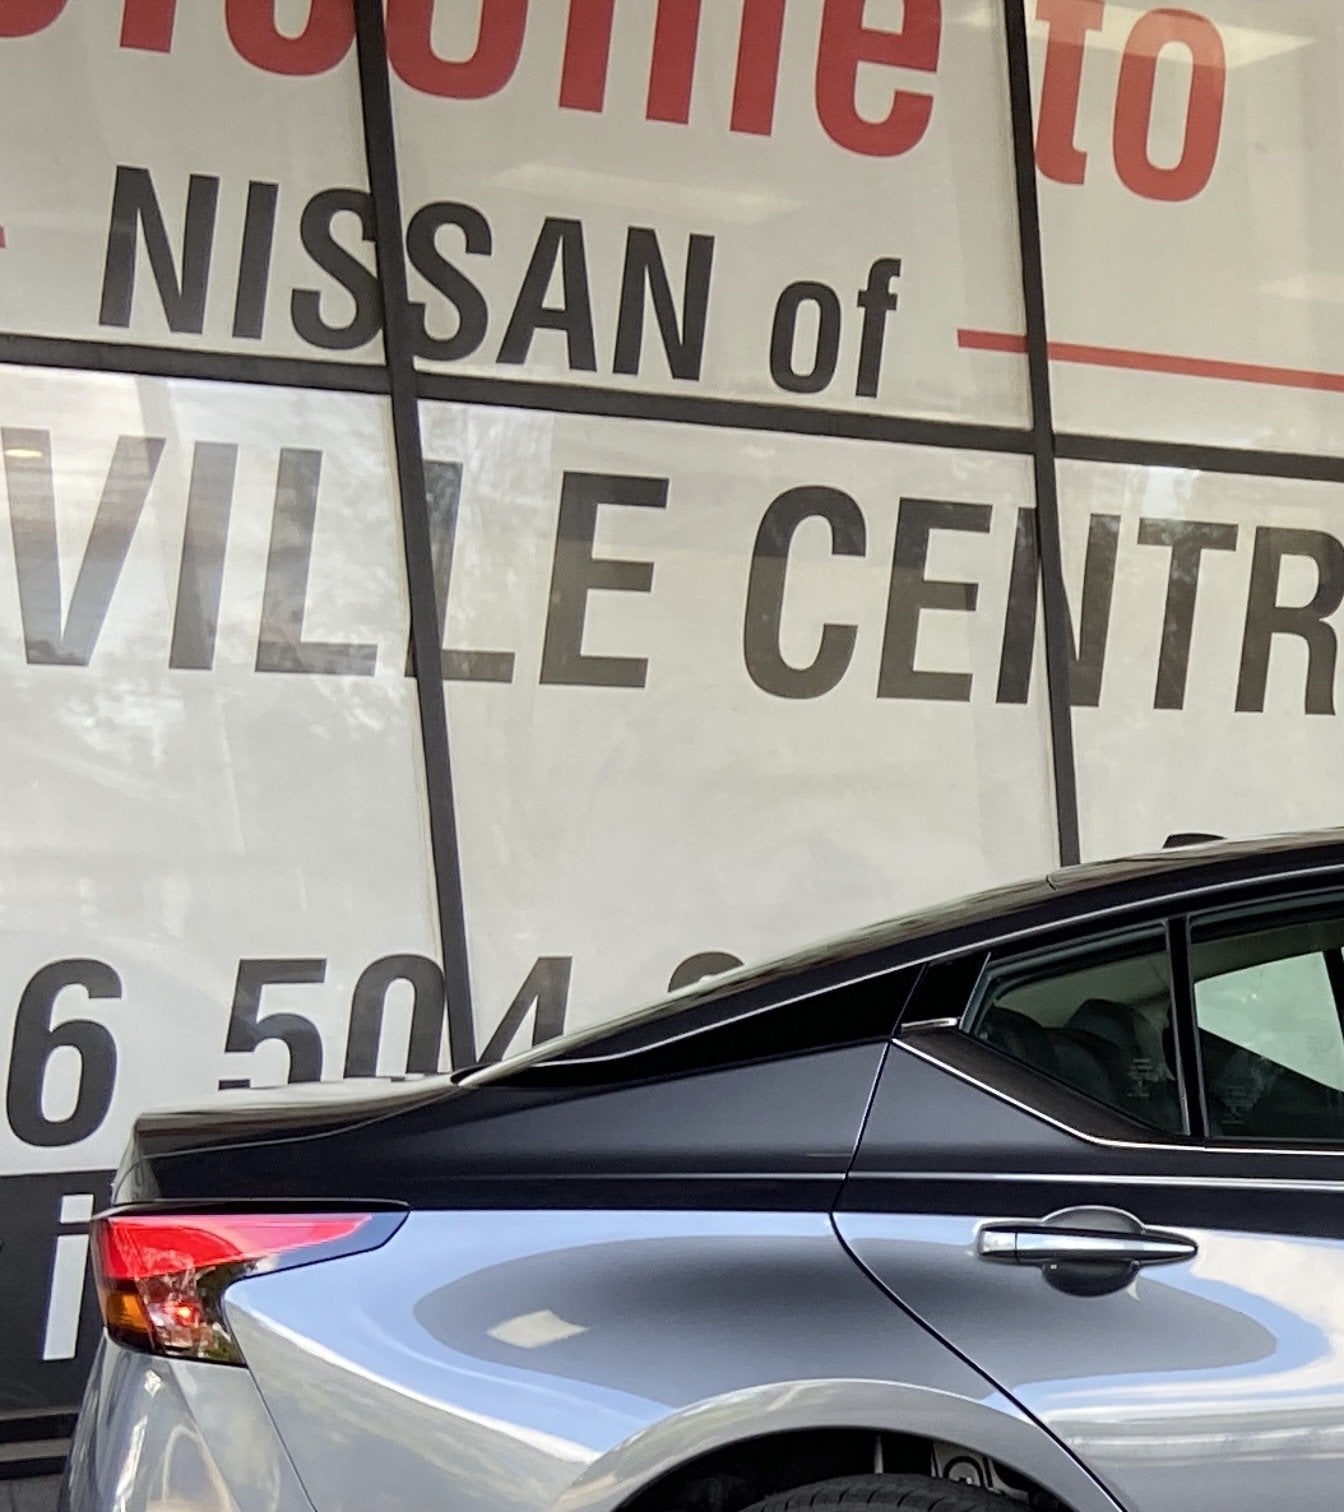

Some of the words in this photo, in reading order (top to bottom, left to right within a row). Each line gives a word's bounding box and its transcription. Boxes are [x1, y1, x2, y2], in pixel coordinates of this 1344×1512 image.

[1034, 0, 1227, 202] to
[98, 164, 715, 382] NISSAN
[769, 257, 902, 398] of
